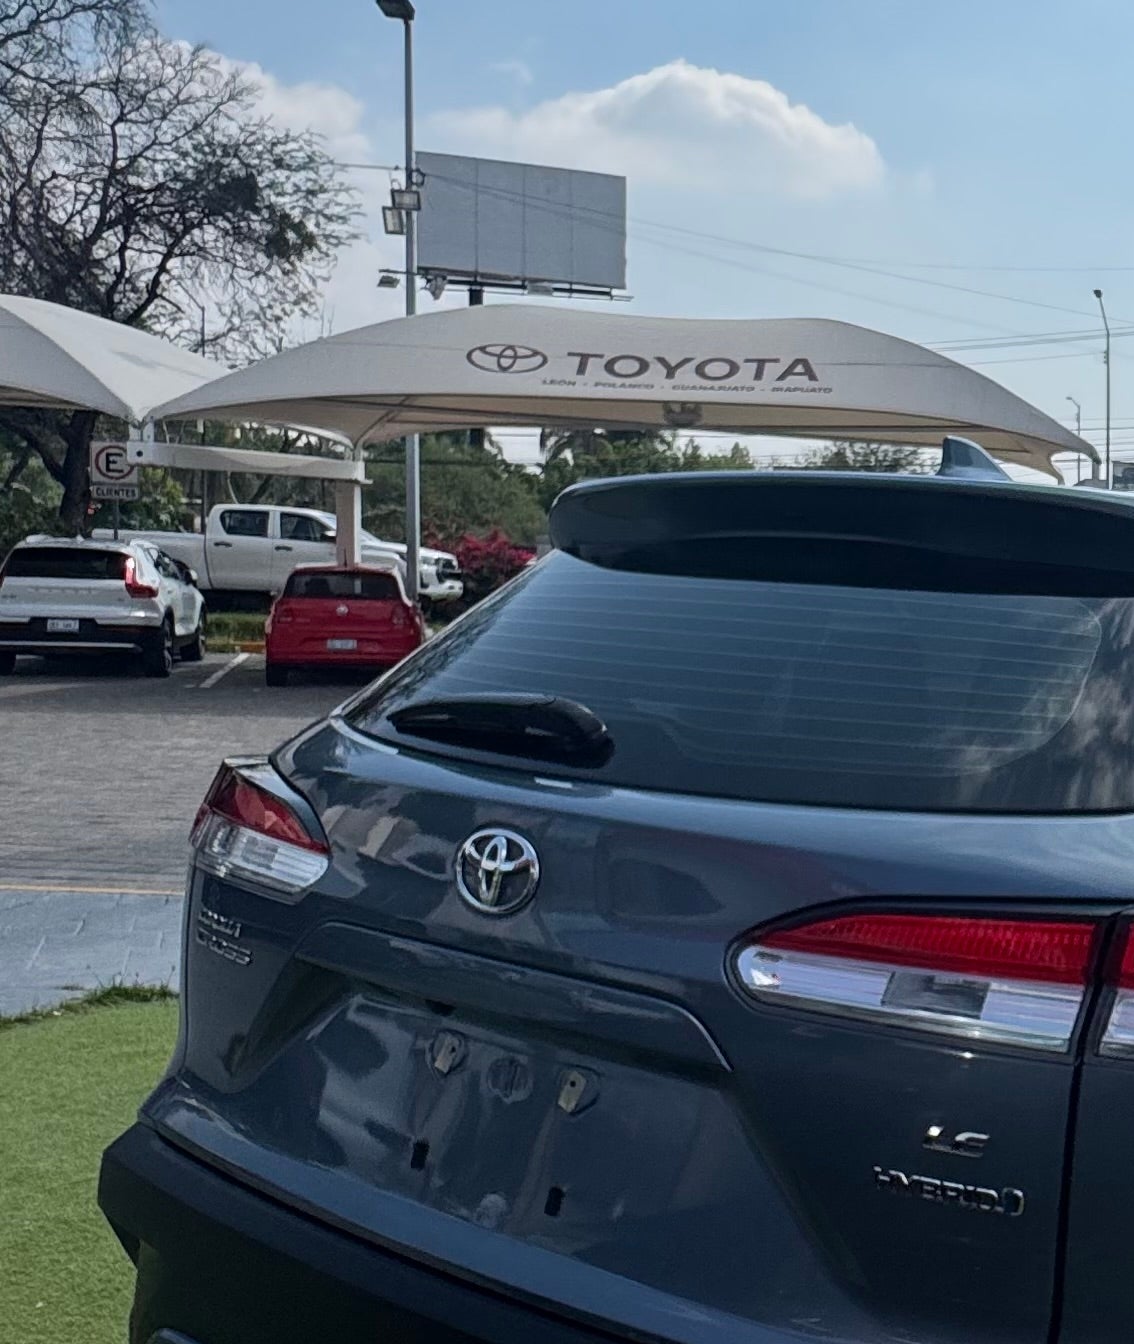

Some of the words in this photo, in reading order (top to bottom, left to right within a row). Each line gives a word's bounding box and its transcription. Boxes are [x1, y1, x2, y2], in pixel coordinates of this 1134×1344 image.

[566, 351, 819, 382] TOYOTA
[105, 452, 124, 474] E
[95, 487, 137, 498] CLIENTES
